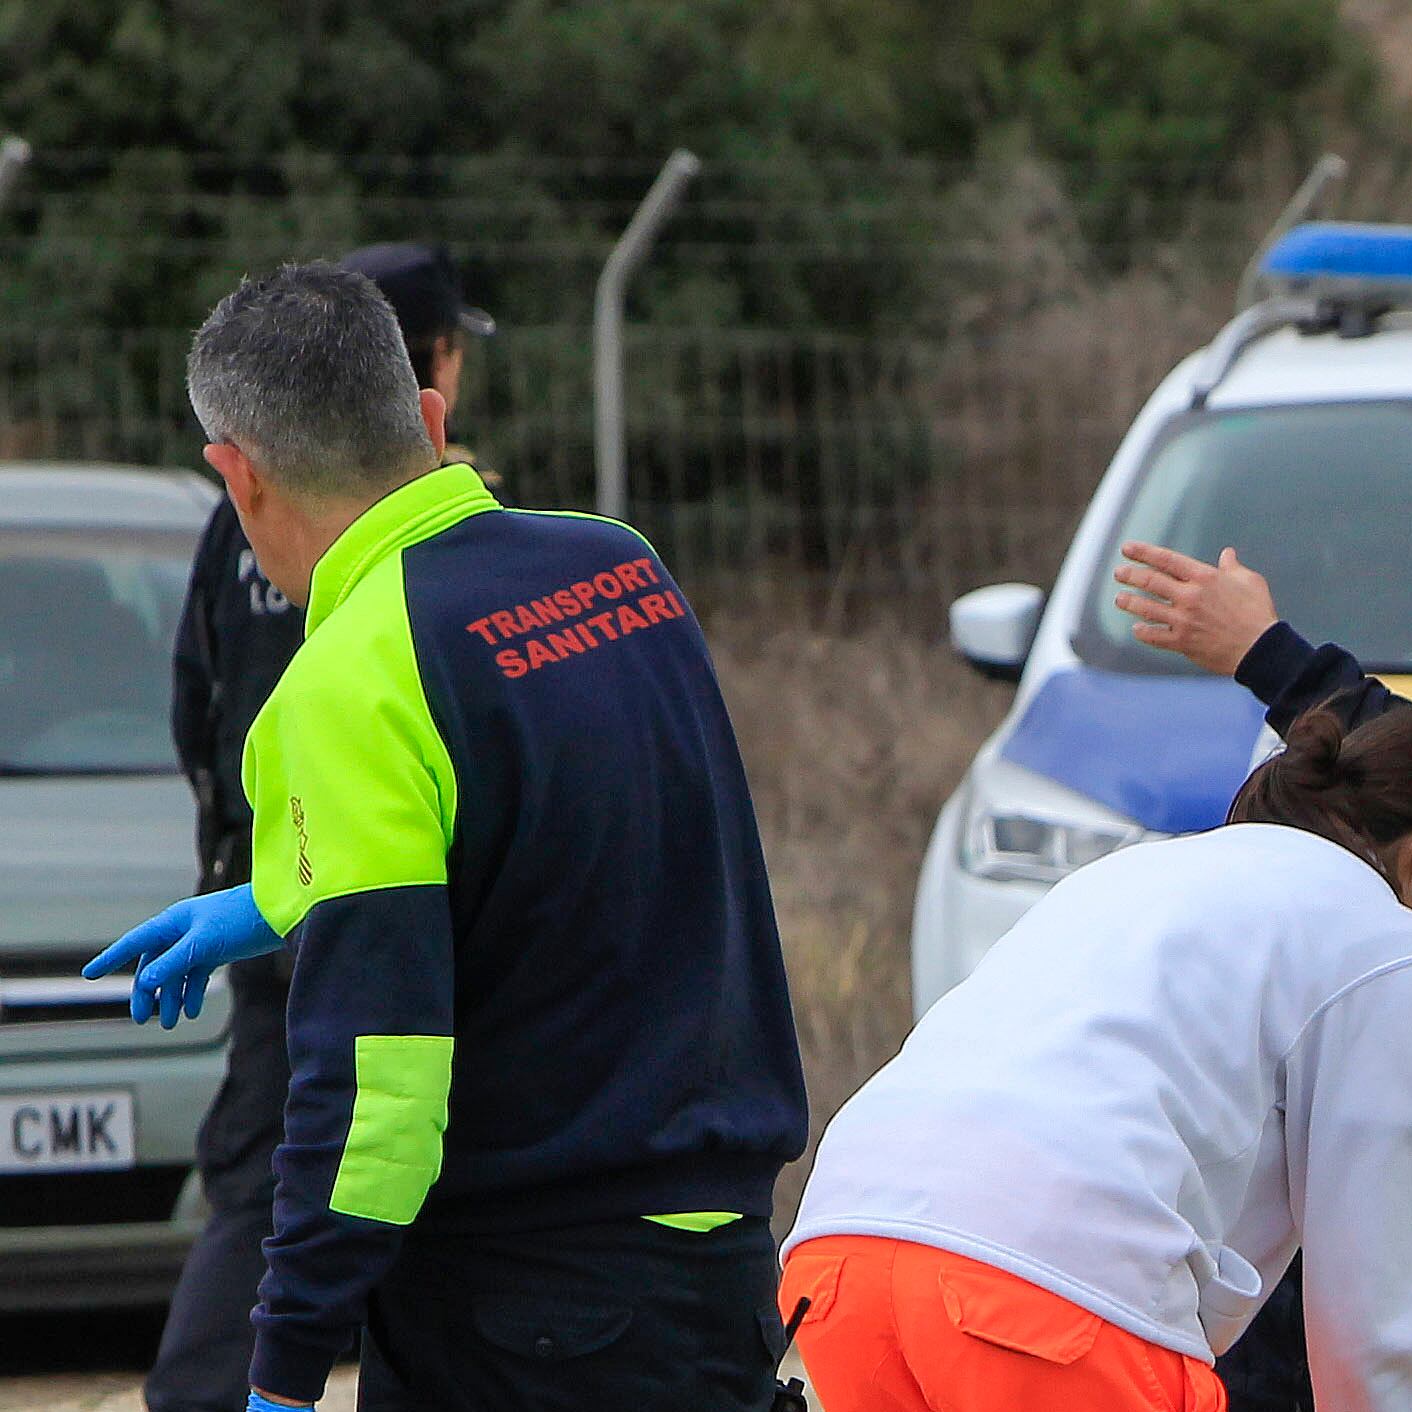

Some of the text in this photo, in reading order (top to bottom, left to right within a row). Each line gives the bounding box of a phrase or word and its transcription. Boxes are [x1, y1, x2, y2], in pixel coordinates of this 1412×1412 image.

[466, 558, 659, 645] TRANSPORT
[495, 591, 685, 678] SANITARI
[12, 1104, 117, 1157] CMK
